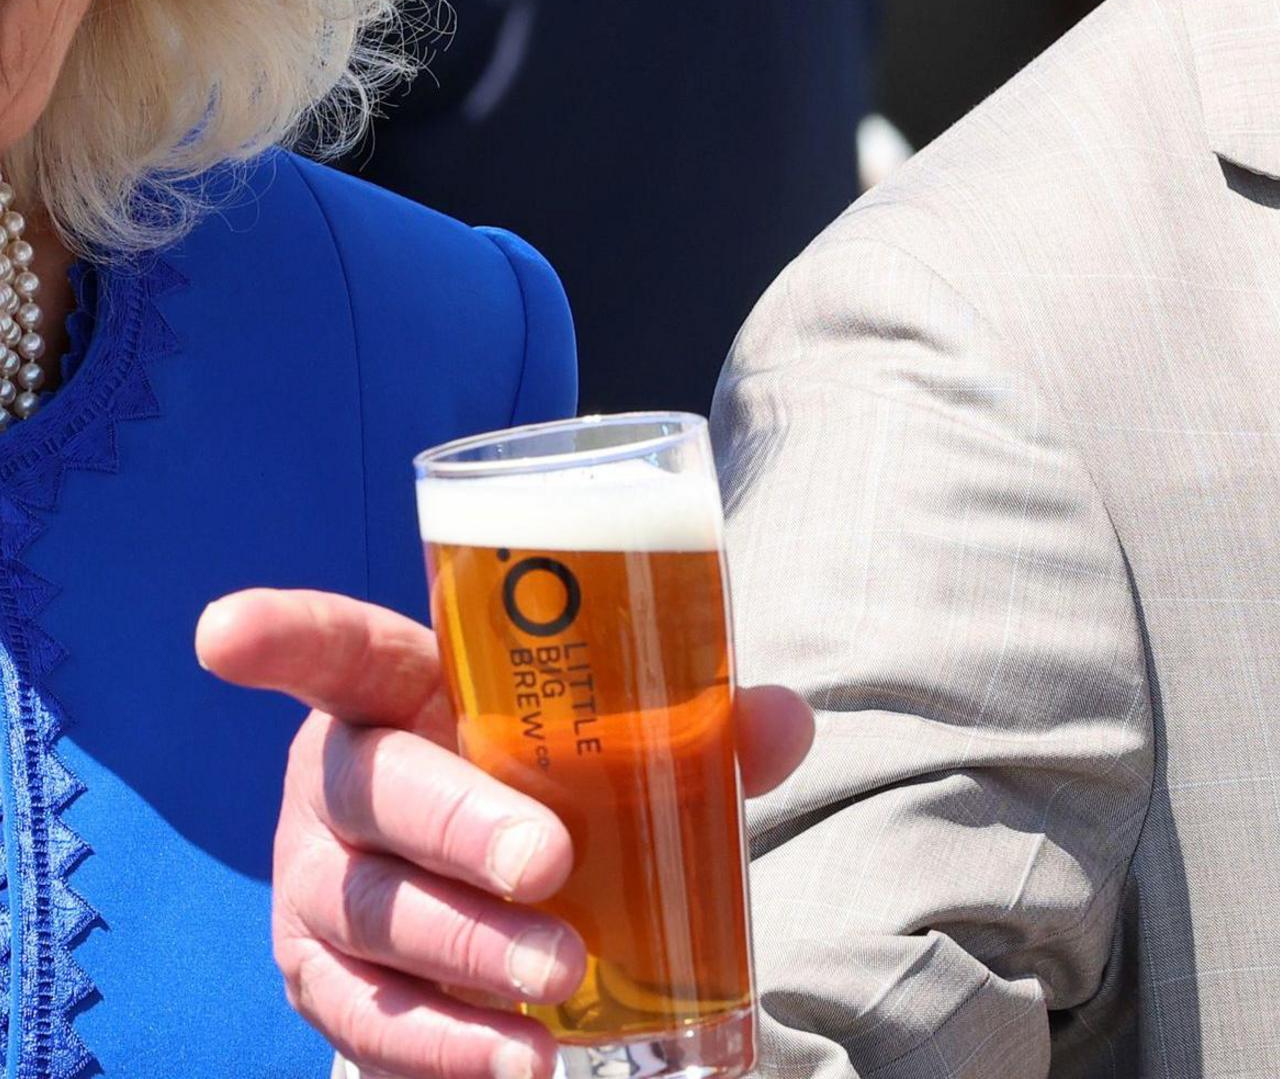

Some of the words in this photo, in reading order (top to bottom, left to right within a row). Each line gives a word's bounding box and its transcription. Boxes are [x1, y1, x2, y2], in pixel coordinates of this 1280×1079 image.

[510, 648, 546, 741] BREW
[536, 645, 565, 699] BIG
[563, 642, 602, 756] LITTLE
